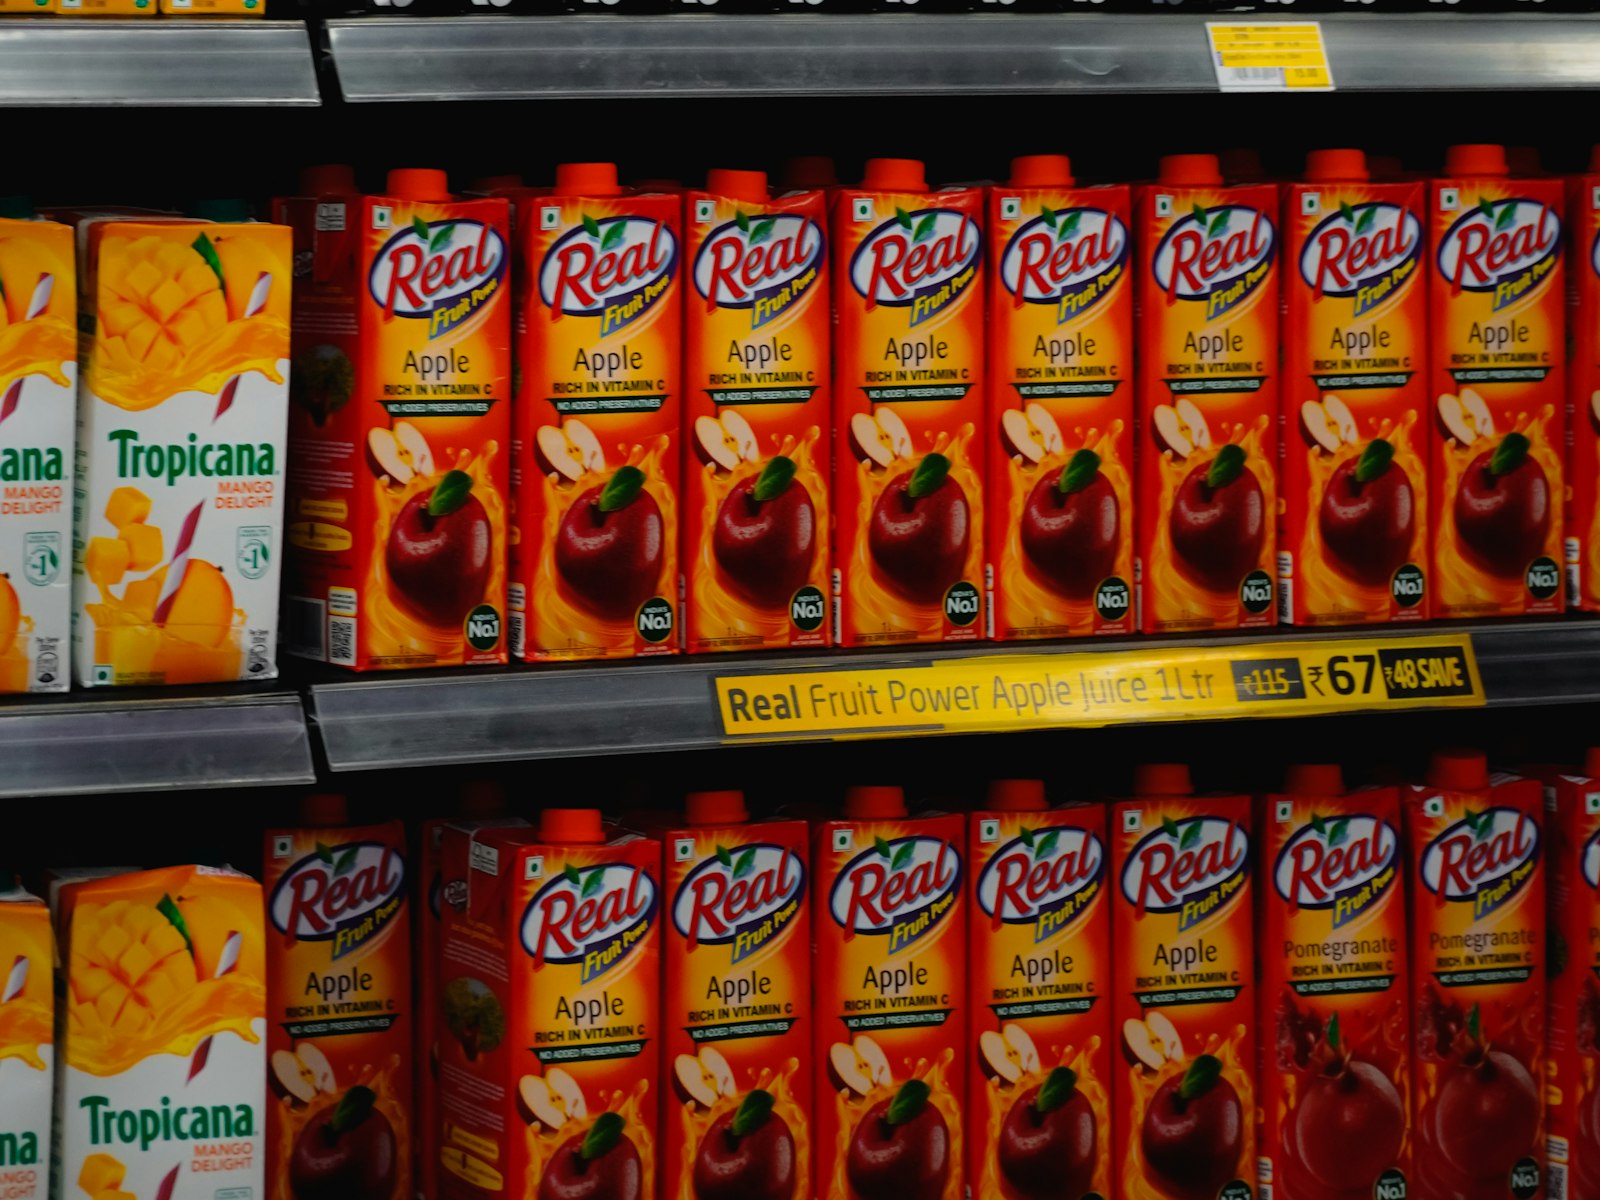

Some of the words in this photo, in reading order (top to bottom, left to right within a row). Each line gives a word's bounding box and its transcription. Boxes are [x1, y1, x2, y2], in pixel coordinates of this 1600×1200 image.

[707, 216, 815, 316] Real
[865, 213, 975, 314] Real
[1014, 210, 1119, 311] Real
[1166, 209, 1267, 308] Real
[1313, 206, 1413, 304] Real
[1451, 203, 1554, 299] Real
[383, 220, 498, 325] Real
[551, 221, 670, 324] Real
[431, 296, 471, 338] Fruit
[471, 278, 498, 304] Power
[884, 334, 949, 367] Apple
[1033, 332, 1096, 363] Apple
[1184, 328, 1244, 360] Apple
[1330, 324, 1391, 355] Apple
[1467, 319, 1529, 350] Apple
[403, 347, 470, 380] Apple
[573, 345, 643, 379] Apple
[727, 336, 793, 369] Apple
[383, 384, 412, 397] RICH
[415, 384, 428, 397] IN
[430, 383, 481, 397] VITAMIN
[484, 383, 492, 395] C
[108, 429, 275, 487] Tropicana
[3, 486, 63, 500] MANGO
[215, 495, 273, 509] DELIGHT
[217, 481, 274, 494] MANGO
[1, 501, 62, 516] DELIGHT
[726, 684, 801, 722] Real
[809, 680, 883, 719] Fruit
[888, 679, 981, 715] Power
[992, 672, 1073, 717] Apple
[1079, 670, 1148, 713] Juice
[1161, 666, 1214, 701] 1Ltr
[1135, 819, 1242, 922] Real
[1288, 817, 1391, 918] Real
[1435, 807, 1532, 910] Real
[285, 846, 400, 949] Real
[843, 840, 954, 944] Real
[991, 830, 1097, 933] Real
[686, 847, 796, 954] Real
[532, 865, 650, 972] Real
[583, 939, 621, 980] Fruit
[622, 919, 649, 947] Power
[1153, 938, 1218, 972] Apple
[1284, 936, 1398, 961] Pomegranate
[1430, 928, 1536, 952] Pomegranate
[305, 966, 373, 999] Apple
[862, 961, 929, 995] Apple
[1010, 950, 1074, 983] Apple
[706, 970, 772, 1004] Apple
[555, 991, 624, 1025] Apple
[535, 1028, 564, 1042] RICH
[568, 1027, 581, 1040] IN
[584, 1025, 634, 1040] VITAMIN
[637, 1024, 645, 1036] C
[80, 1095, 253, 1152] Tropicana
[191, 1157, 253, 1172] DELIGHT
[194, 1142, 253, 1157] MANGO
